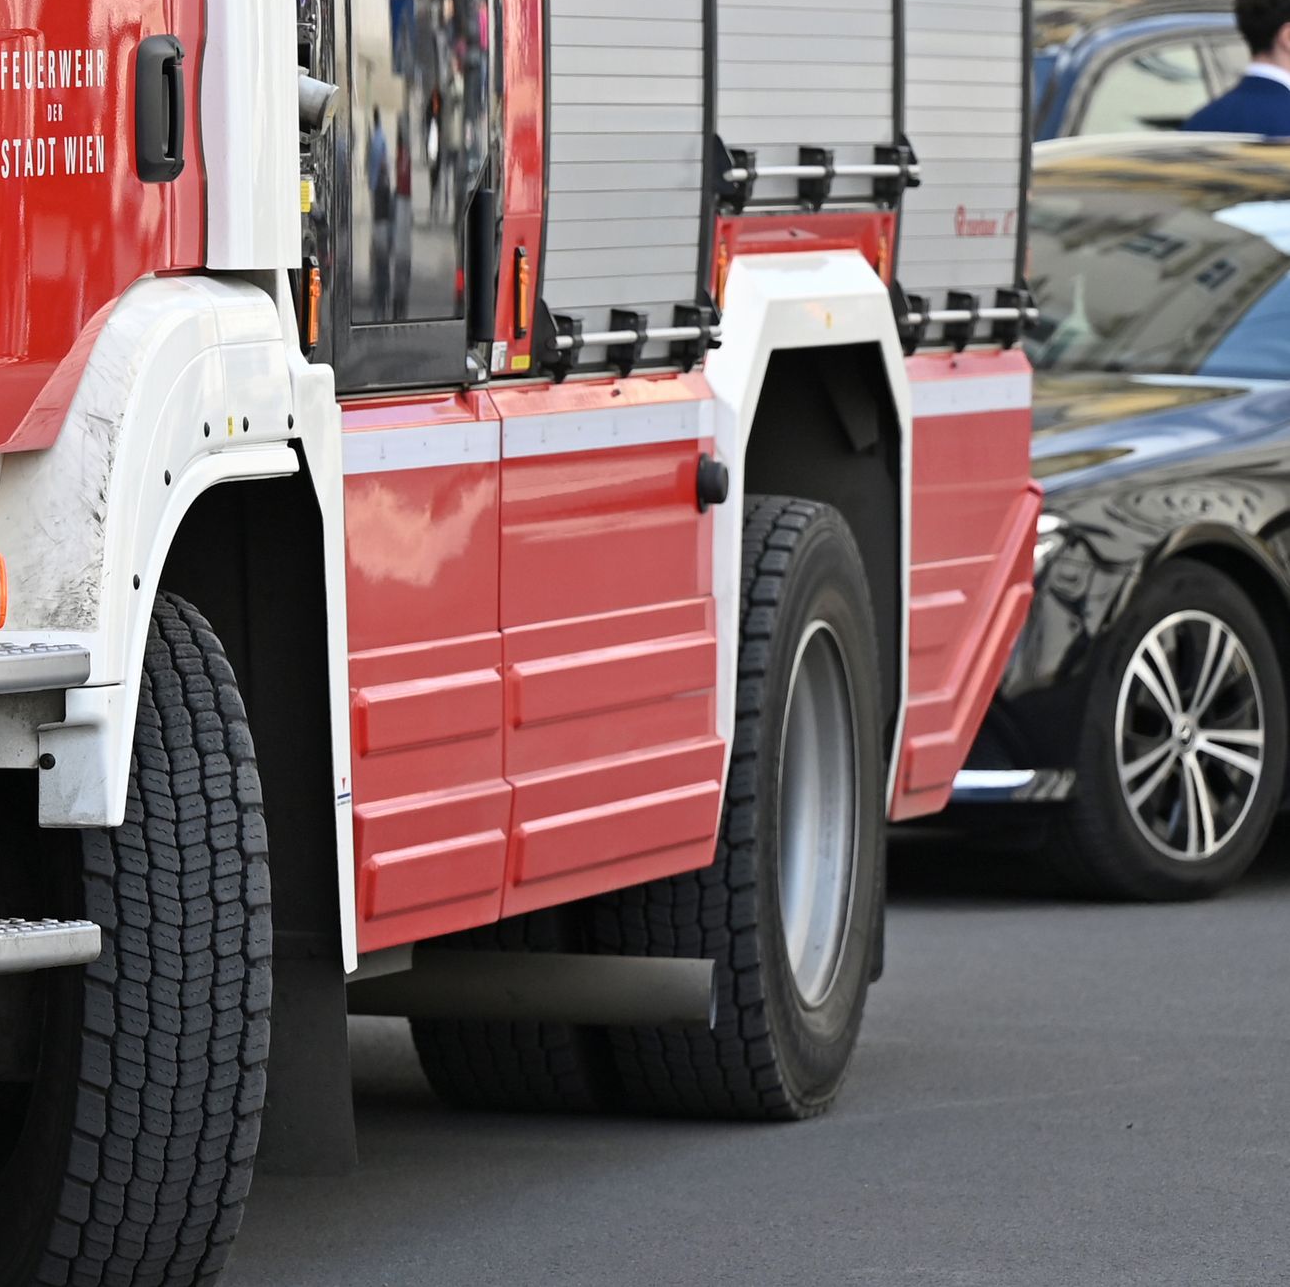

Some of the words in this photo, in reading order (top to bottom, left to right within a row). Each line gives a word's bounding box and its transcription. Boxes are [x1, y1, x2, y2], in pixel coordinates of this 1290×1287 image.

[0, 49, 105, 90] FEUERWEHR
[47, 103, 63, 122] DER
[1, 137, 56, 179] STADT
[63, 135, 105, 175] WIEN
